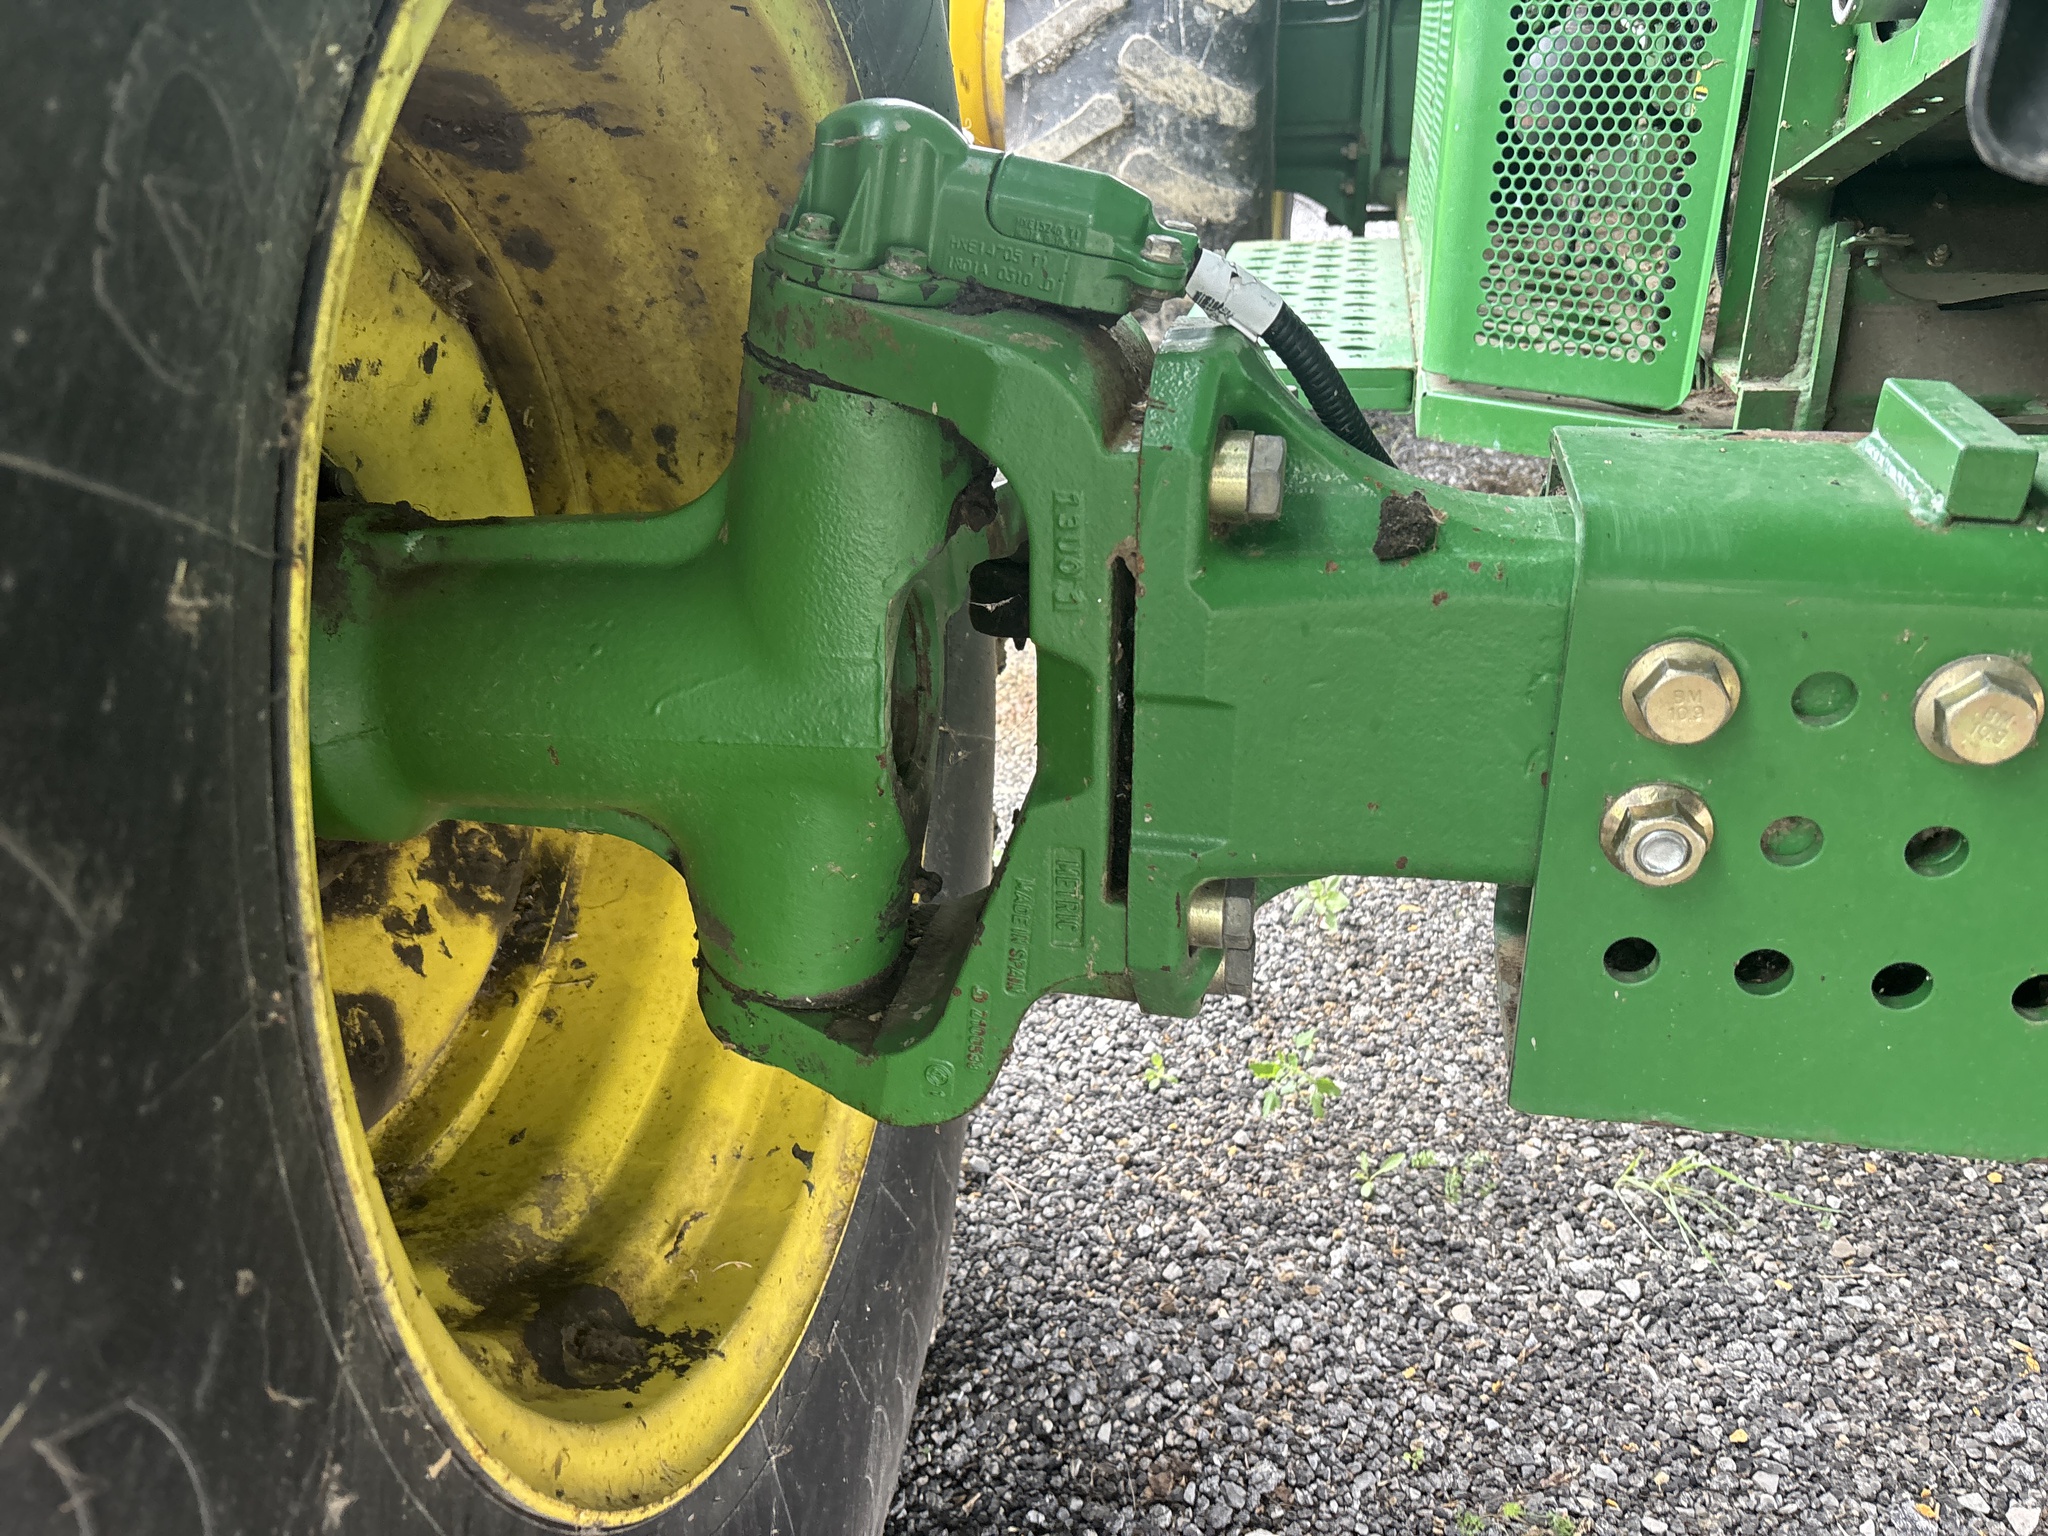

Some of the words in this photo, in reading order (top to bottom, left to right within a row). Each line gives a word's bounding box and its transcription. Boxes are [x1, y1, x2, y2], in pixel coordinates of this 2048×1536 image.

[949, 256, 989, 277] INDIA
[1011, 876, 1036, 923] MADE
[1054, 859, 1082, 933] METRIC
[1010, 926, 1033, 946] IN
[1005, 948, 1029, 995] SPAIN
